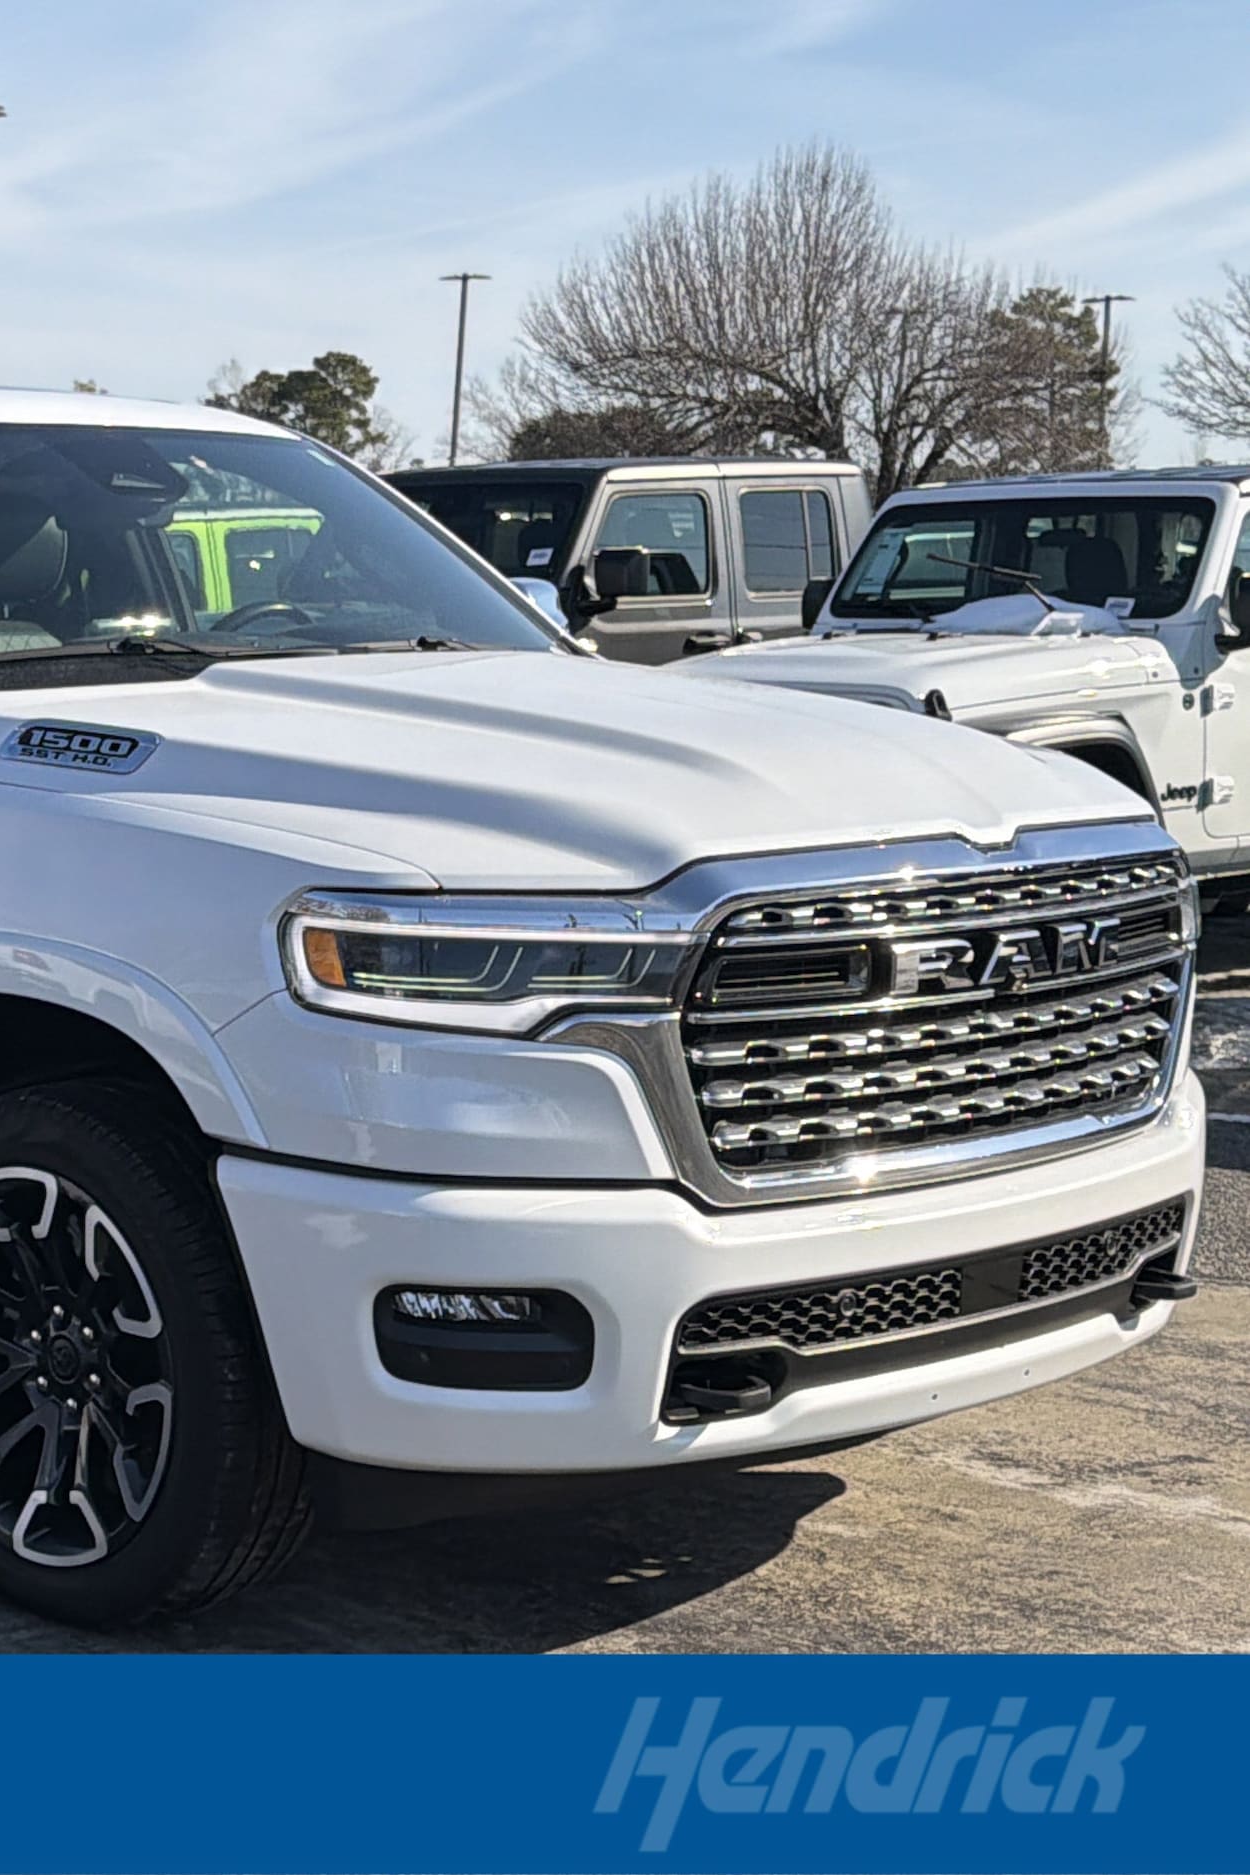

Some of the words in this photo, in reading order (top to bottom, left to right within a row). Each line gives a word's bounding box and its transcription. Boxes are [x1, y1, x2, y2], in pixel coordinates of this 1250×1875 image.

[18, 747, 64, 760] SST
[29, 729, 133, 756] 1500
[1160, 782, 1197, 802] Jeep
[890, 917, 1121, 996] RAM
